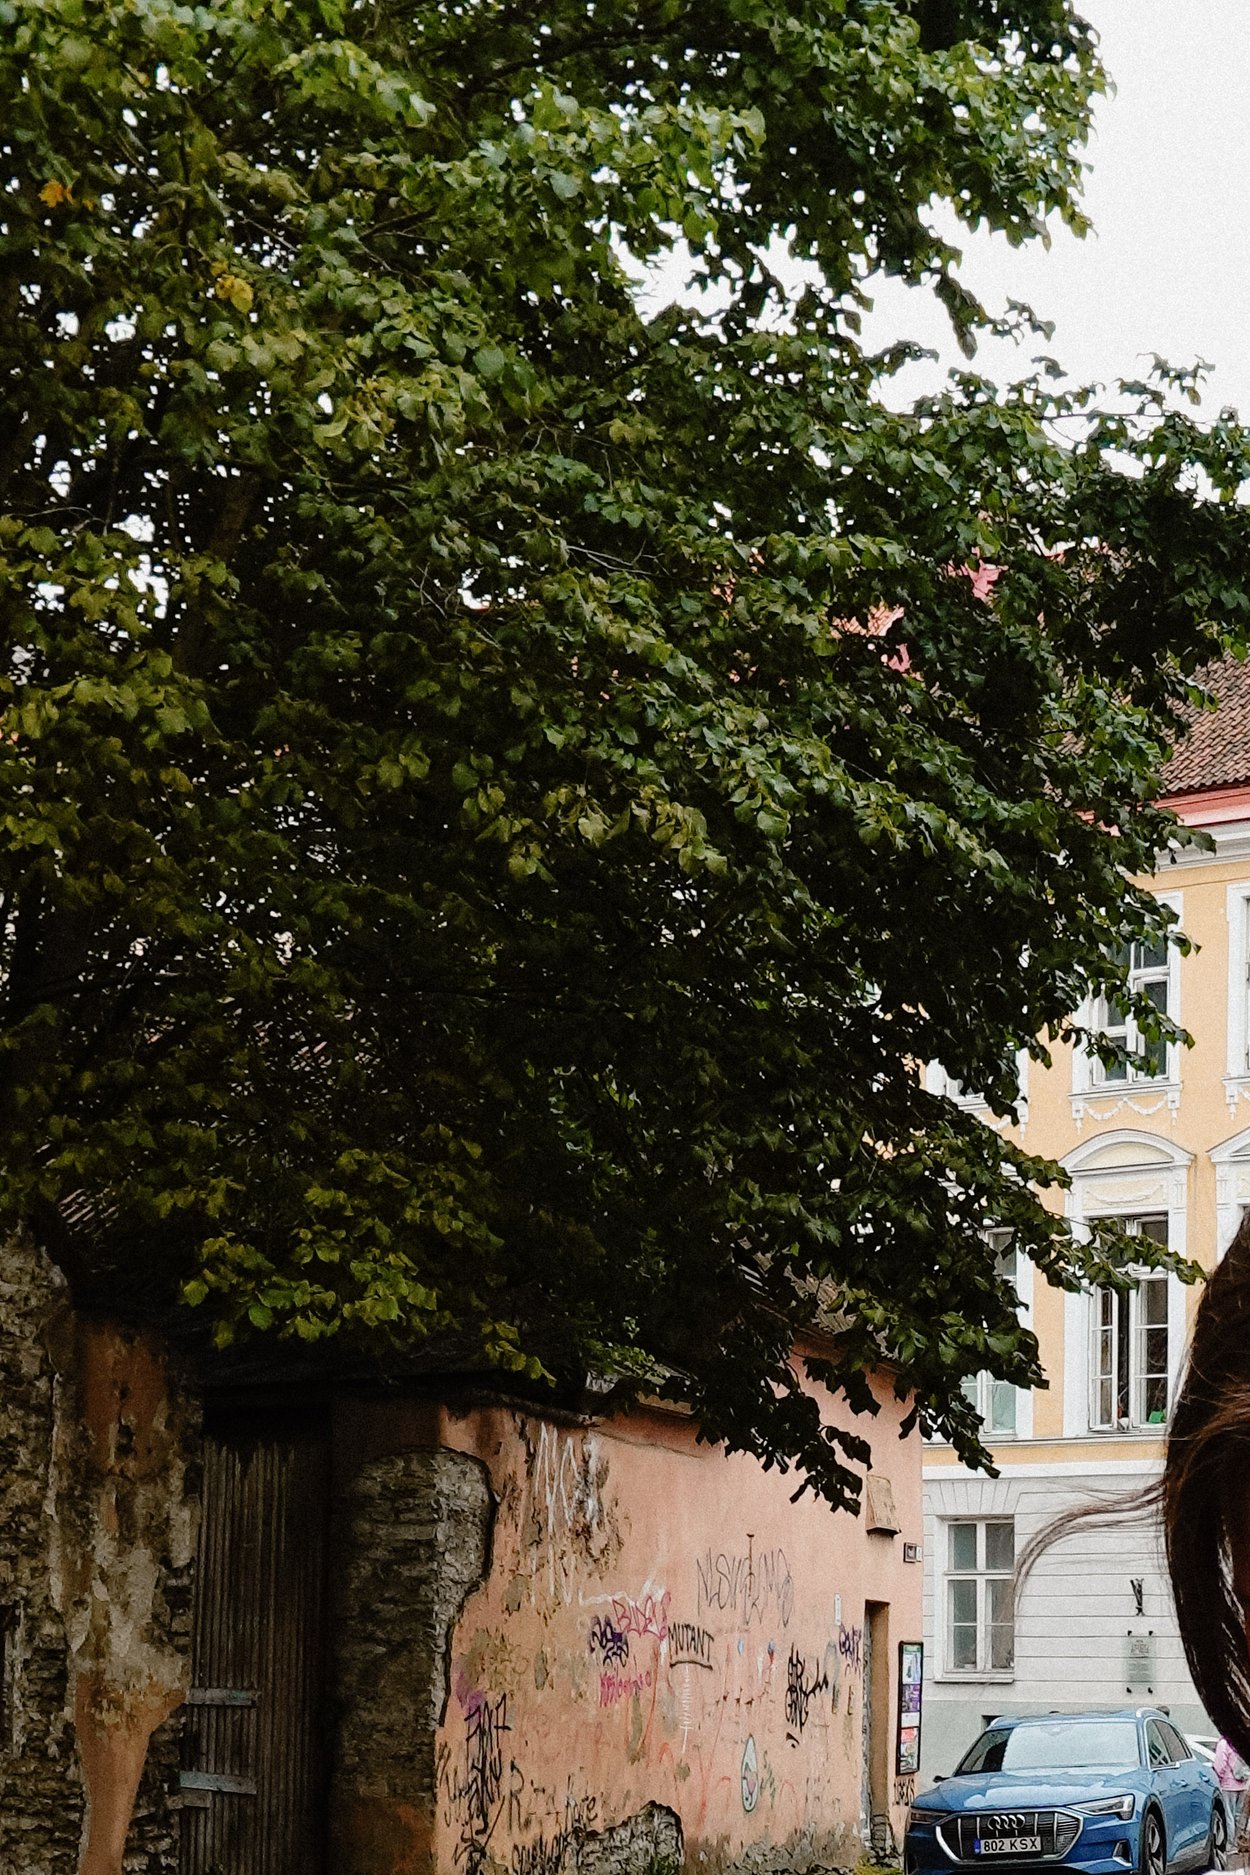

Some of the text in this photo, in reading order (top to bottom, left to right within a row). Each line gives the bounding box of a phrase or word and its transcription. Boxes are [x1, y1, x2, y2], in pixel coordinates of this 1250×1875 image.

[667, 1621, 715, 1663] MUTANT
[984, 1838, 1038, 1852] 802 KSX
